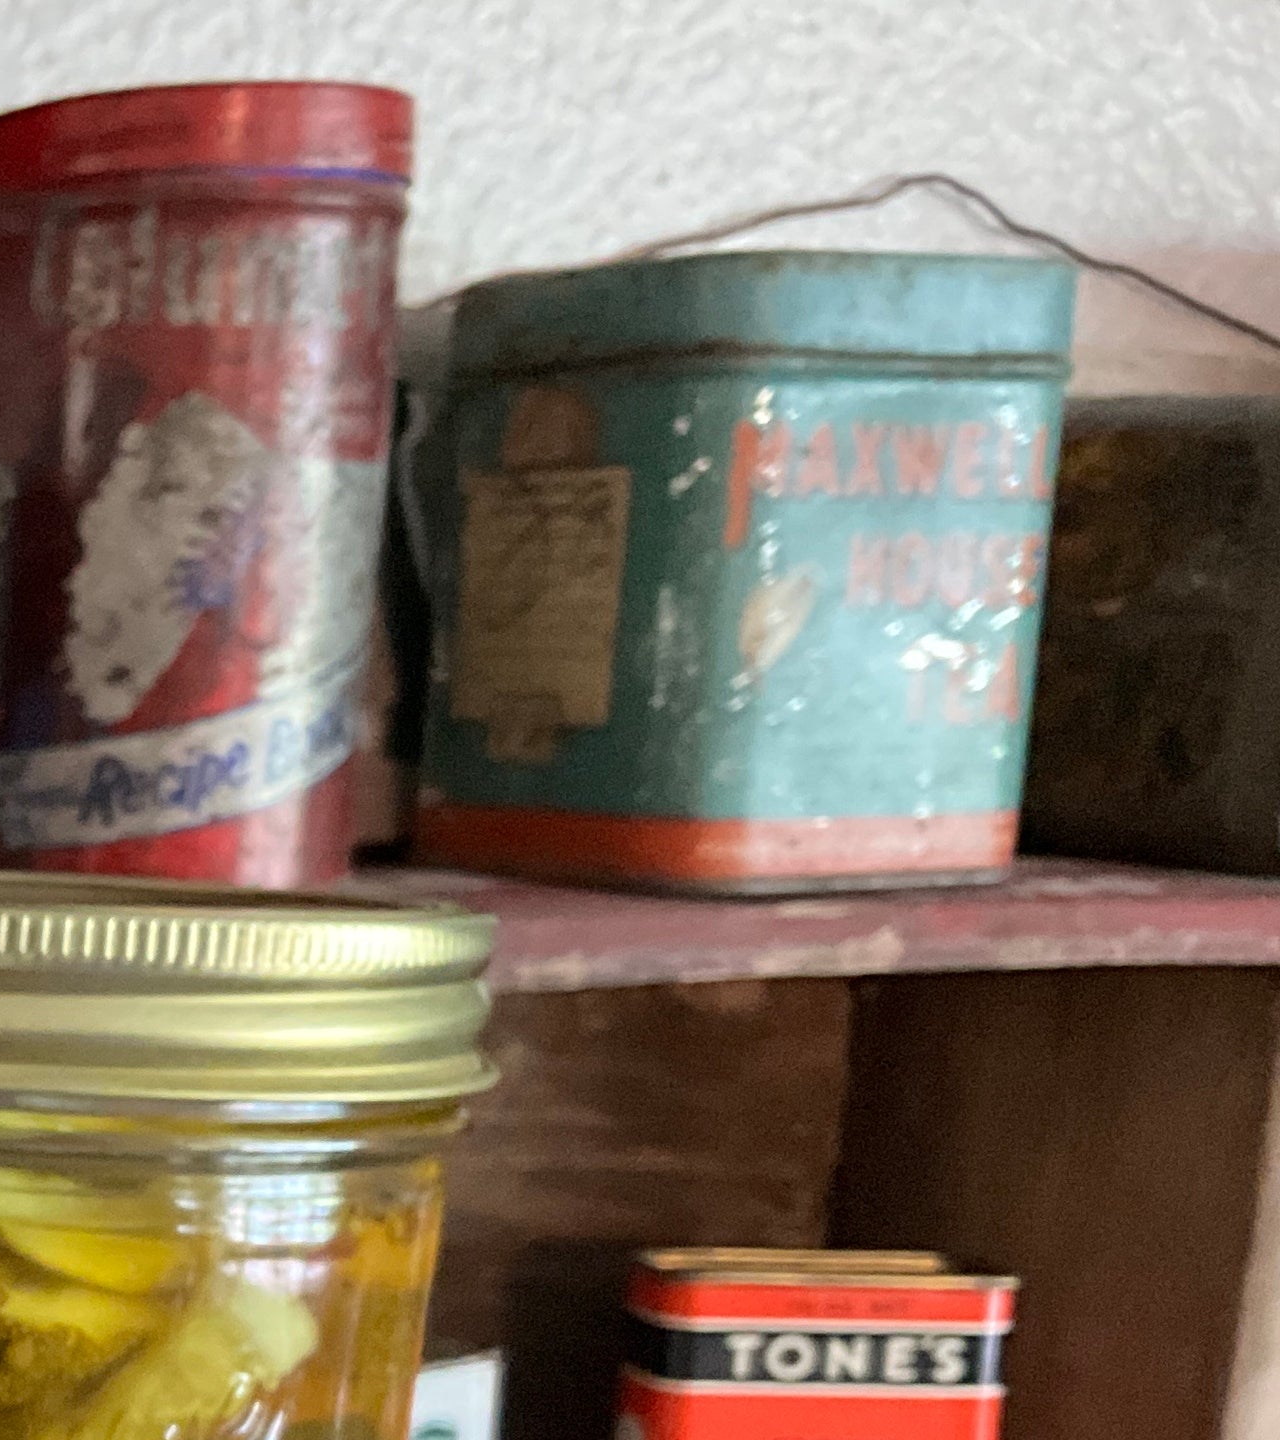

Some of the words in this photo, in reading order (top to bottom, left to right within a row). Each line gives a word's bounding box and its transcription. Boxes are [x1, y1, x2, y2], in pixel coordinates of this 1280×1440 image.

[723, 418, 1053, 550] MAXWELL
[844, 530, 1042, 608] HOUSE
[723, 1332, 966, 1385] TONE'S
